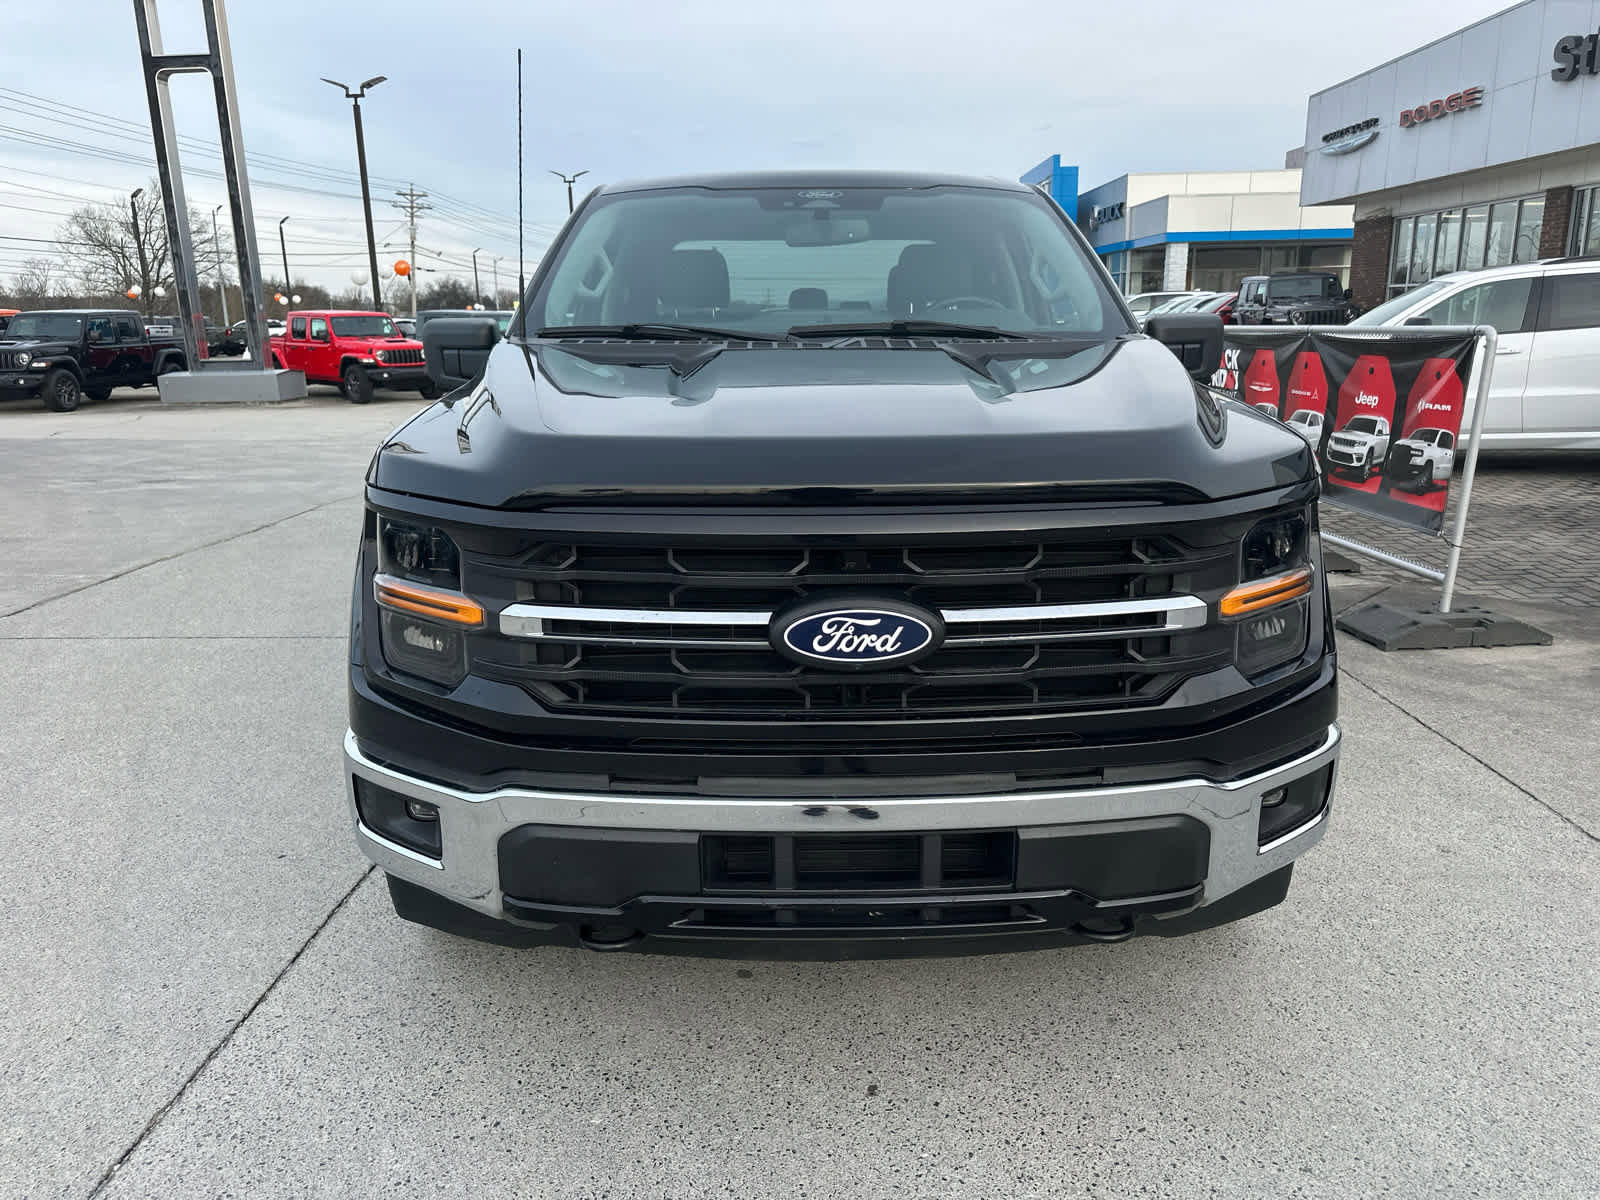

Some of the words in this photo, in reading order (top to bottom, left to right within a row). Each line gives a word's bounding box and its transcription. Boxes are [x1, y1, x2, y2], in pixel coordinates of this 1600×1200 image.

[1400, 86, 1485, 128] DODGE
[1355, 390, 1379, 408] Jeep
[1425, 403, 1452, 412] RAM
[812, 616, 904, 653] Ford
